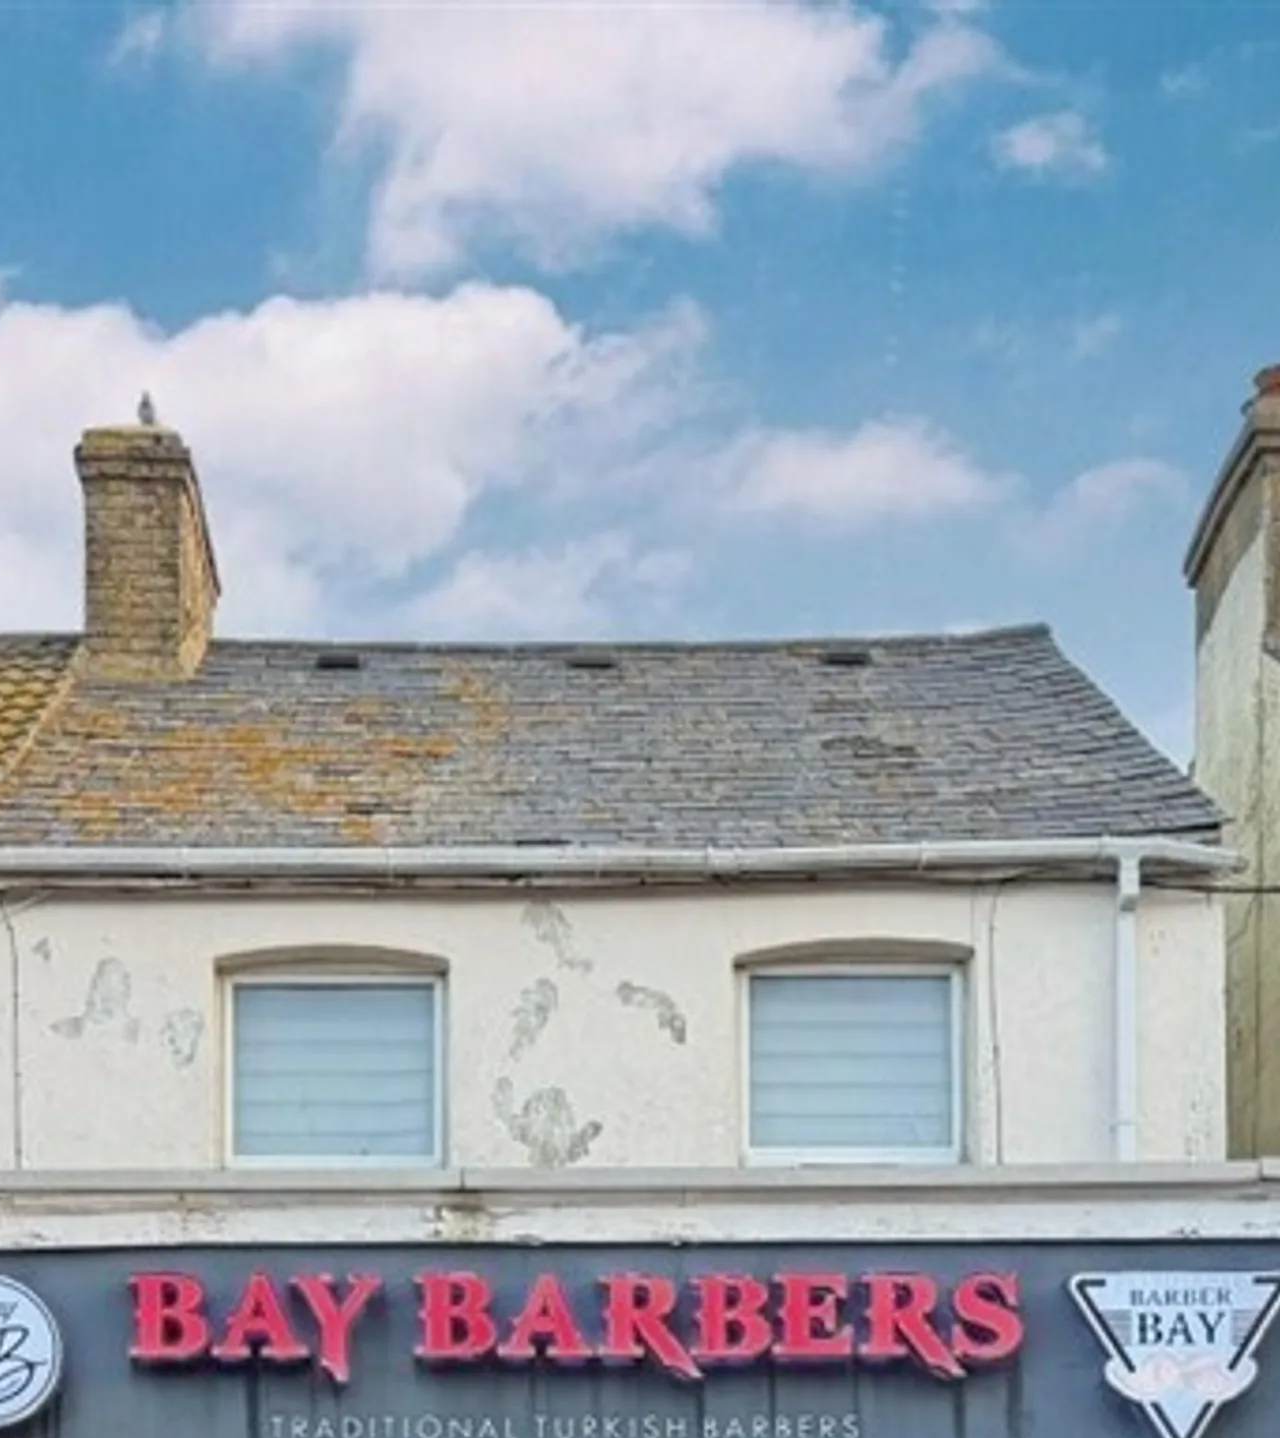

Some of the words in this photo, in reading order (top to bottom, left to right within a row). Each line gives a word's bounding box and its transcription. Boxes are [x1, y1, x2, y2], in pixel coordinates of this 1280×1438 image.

[1129, 1287, 1235, 1307] BARBER
[126, 1267, 386, 1384] BAY
[411, 1267, 1024, 1381] BARBERS
[1137, 1311, 1227, 1346] BAY
